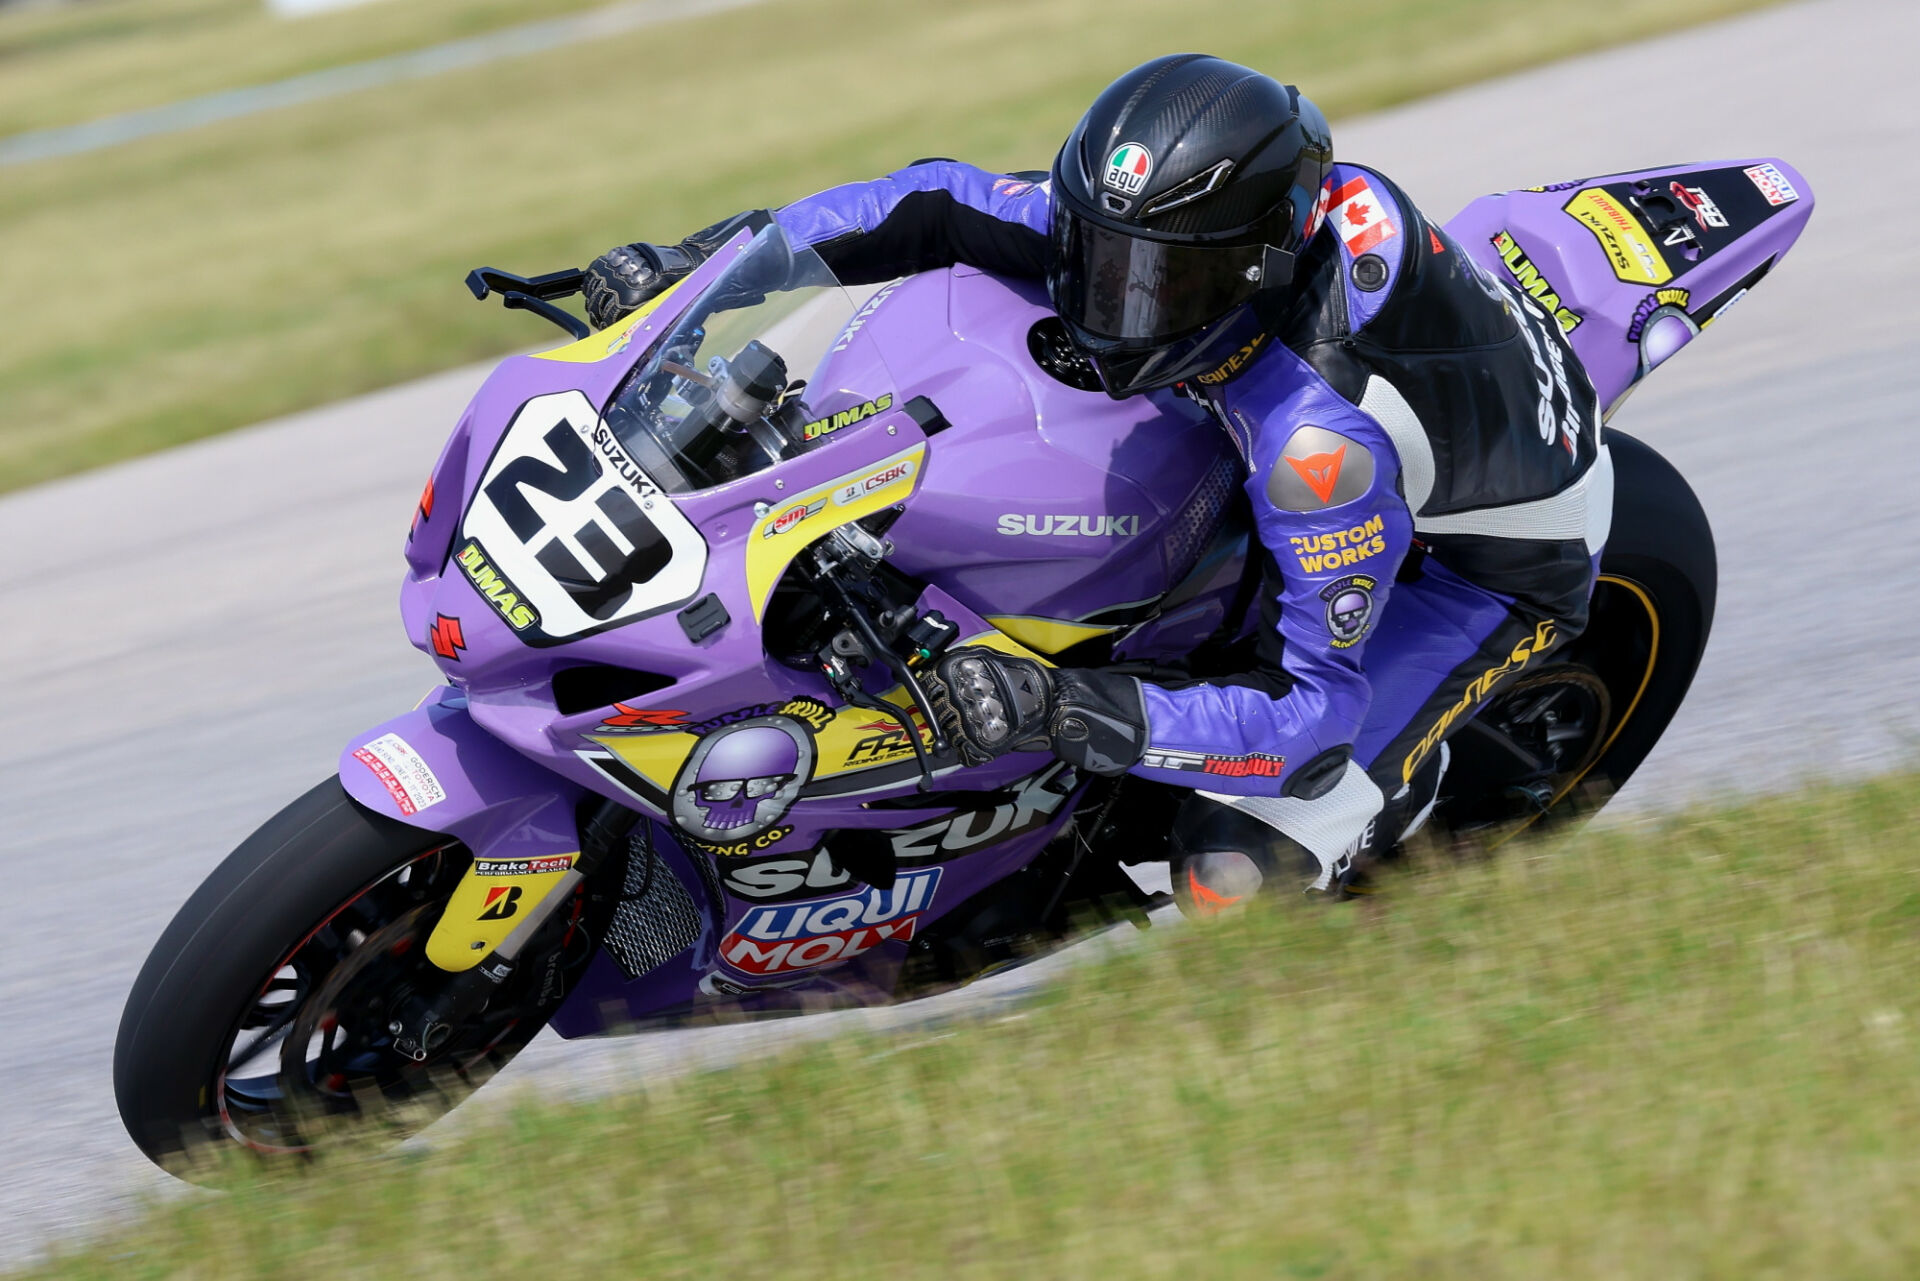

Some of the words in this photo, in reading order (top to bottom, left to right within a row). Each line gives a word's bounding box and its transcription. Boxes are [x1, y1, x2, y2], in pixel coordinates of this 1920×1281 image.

[1587, 194, 1633, 230] THIBAULT
[1580, 210, 1630, 270] SUZUKI
[1492, 229, 1582, 333] DUMAS
[831, 276, 905, 353] UZUKI
[1629, 294, 1660, 342] PURPLE
[1656, 289, 1690, 308] SKULL
[803, 393, 893, 441] DUMAS
[596, 428, 658, 498] SUZUKI
[865, 463, 908, 492] CSBK
[483, 417, 674, 621] 23
[996, 513, 1139, 537] SUZUKI
[1290, 514, 1385, 555] CUSTOM
[1299, 535, 1386, 573] WORKS
[458, 543, 538, 629] DUMAS
[778, 701, 832, 729] SKULL
[410, 757, 441, 798] GODERICH
[1203, 757, 1284, 777] THIBAULT
[755, 828, 791, 848] CO.
[478, 858, 568, 871] BrakeTech
[746, 869, 934, 940] LIQUI
[726, 916, 918, 972] MOLY
